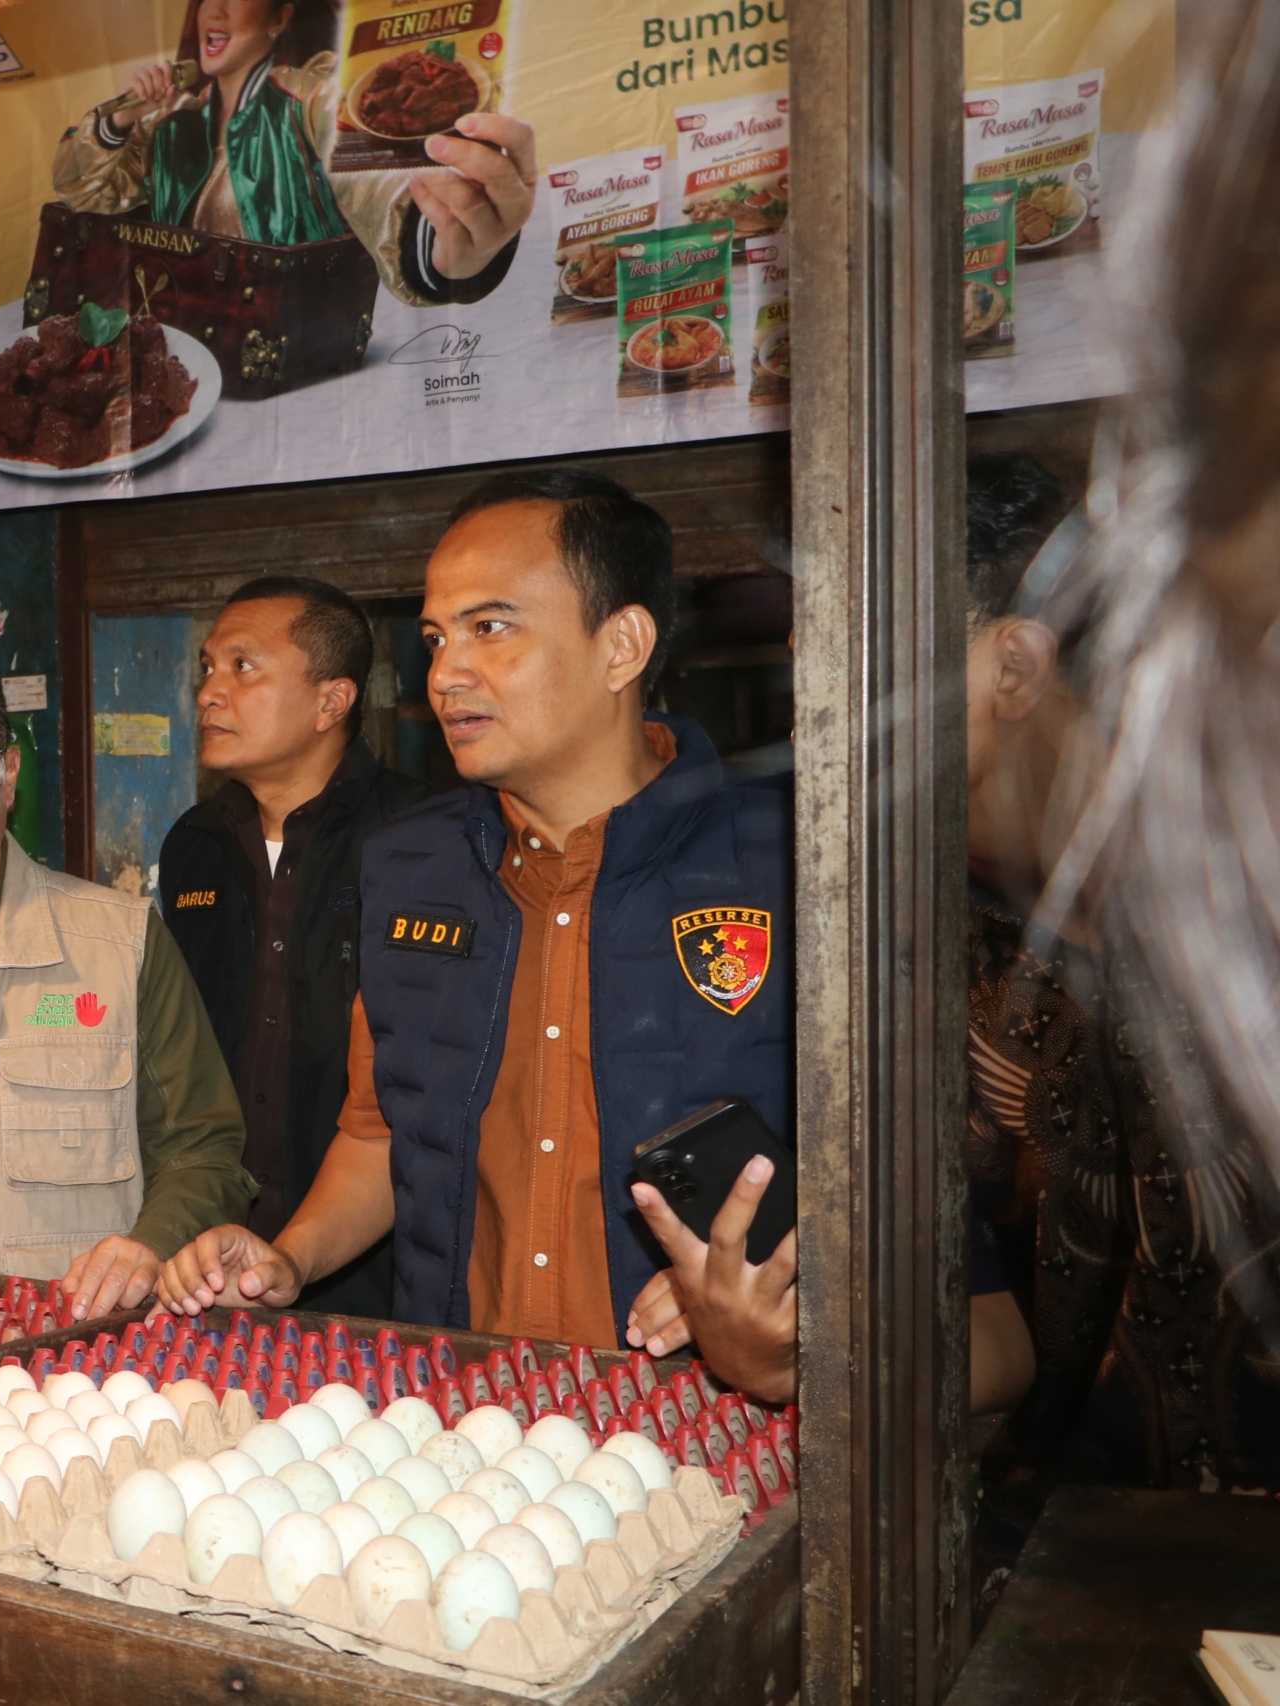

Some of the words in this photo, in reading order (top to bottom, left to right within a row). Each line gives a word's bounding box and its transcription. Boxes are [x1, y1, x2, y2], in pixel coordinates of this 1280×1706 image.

[377, 4, 473, 41] RENDANG
[643, 0, 788, 48] Bumbu
[616, 48, 694, 92] dari
[708, 38, 788, 77] Mas
[968, 0, 1022, 27] sa
[695, 166, 725, 186] IKAN
[729, 152, 780, 177] GORENG
[977, 162, 1012, 179] TEMPE
[1014, 153, 1043, 170] TAHU
[1045, 140, 1089, 161] GORENG
[119, 223, 195, 254] WARISAN
[566, 222, 598, 240] AYAM
[601, 208, 649, 232] GORENG
[964, 248, 995, 266] YAM
[633, 294, 673, 313] GULAI
[678, 282, 716, 302] AYAM
[767, 303, 789, 320] SAT
[424, 371, 480, 391] Soimah
[440, 396, 446, 404] &
[392, 917, 461, 947] BUDI
[680, 911, 762, 930] RESERSE
[36, 1005, 75, 1016] BOROS
[41, 994, 74, 1005] STOP
